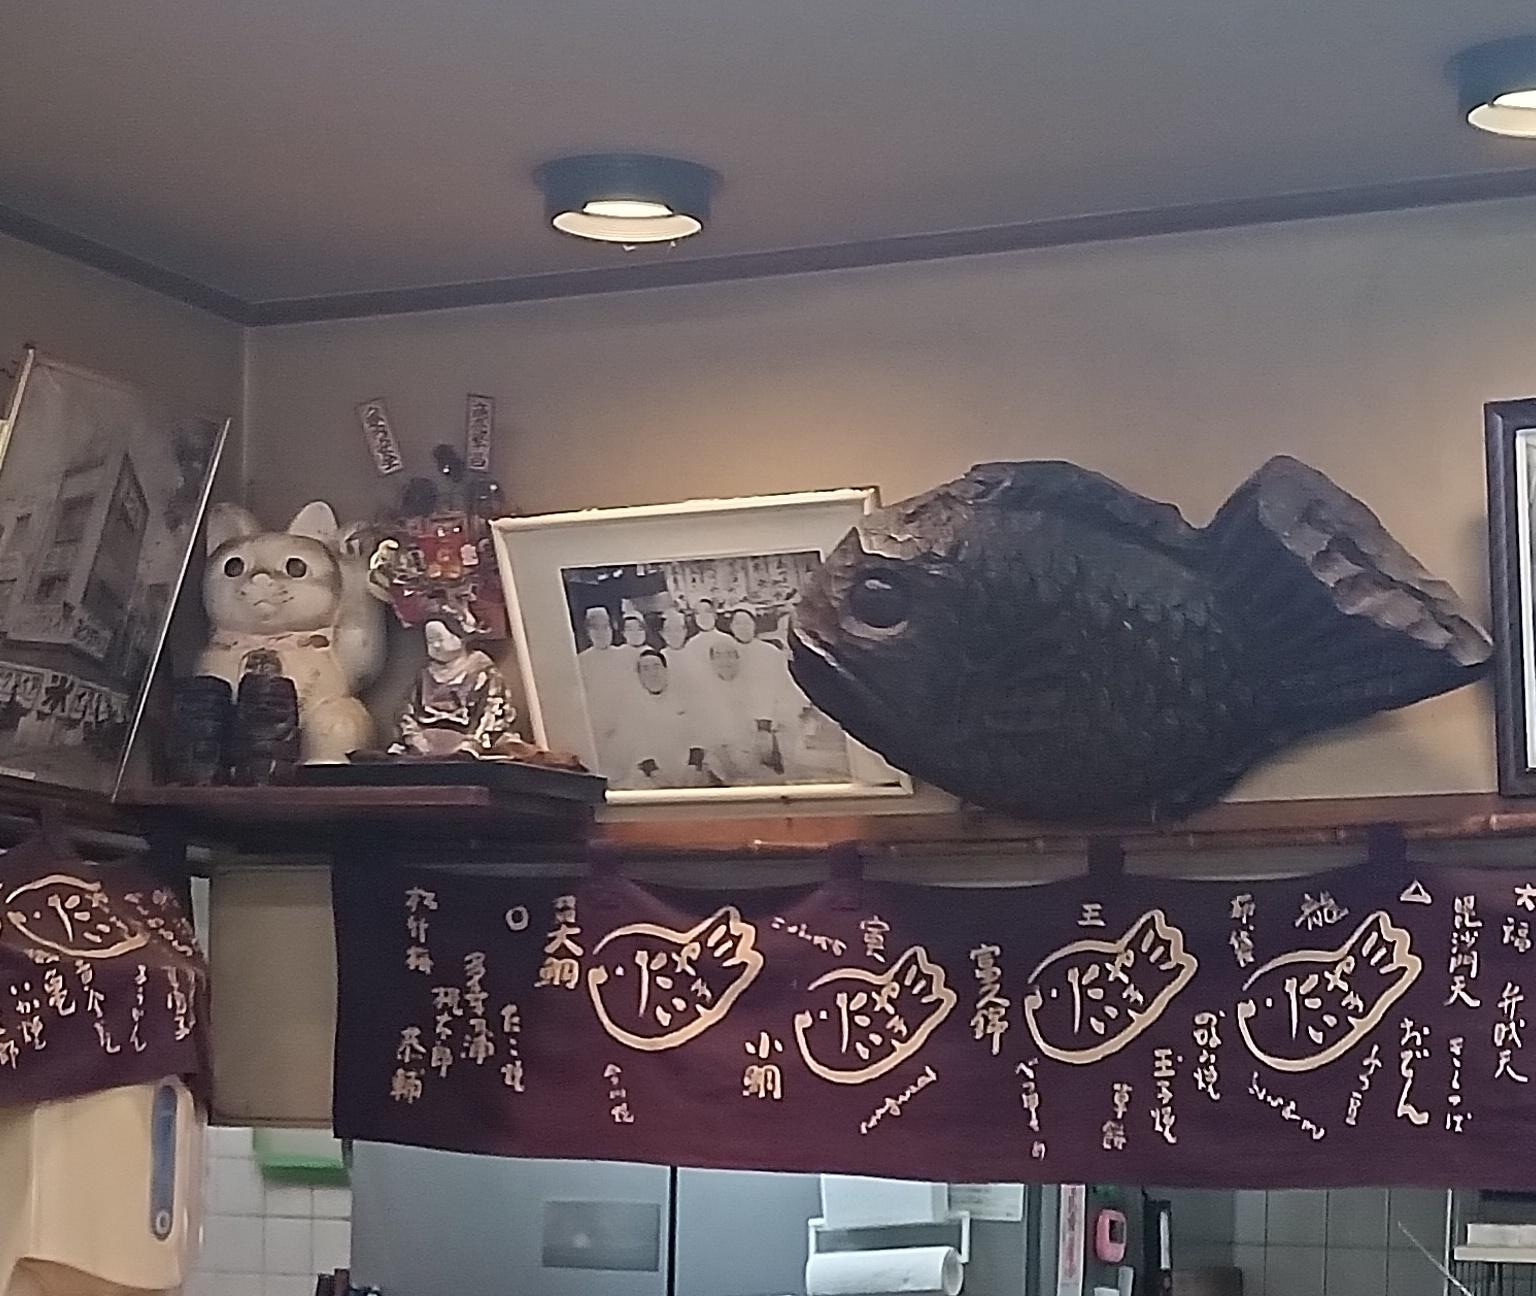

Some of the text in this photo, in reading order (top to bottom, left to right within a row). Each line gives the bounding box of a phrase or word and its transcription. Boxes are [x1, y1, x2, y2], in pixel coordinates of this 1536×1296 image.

[634, 941, 713, 1027] たいやき
[835, 981, 908, 1062] たいやき
[1067, 949, 1145, 1036] たいやき
[1284, 955, 1364, 1045] たいやき
[1396, 1016, 1431, 1126] おでん
